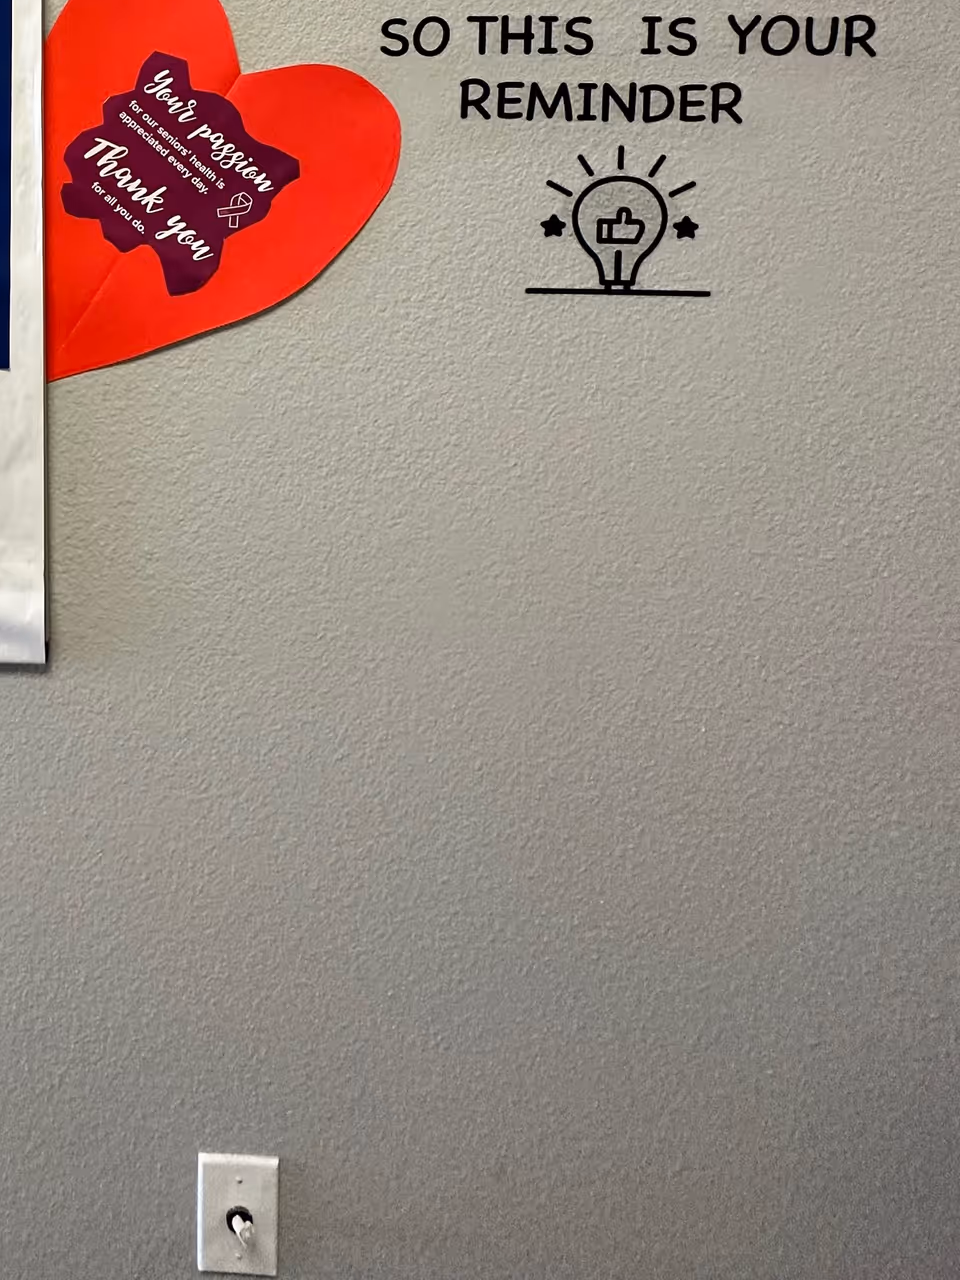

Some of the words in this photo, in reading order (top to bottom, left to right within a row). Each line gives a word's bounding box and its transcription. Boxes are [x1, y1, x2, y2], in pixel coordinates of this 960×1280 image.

[380, 16, 451, 57] SO
[467, 15, 594, 55] THIS
[641, 16, 697, 56] IS
[728, 14, 877, 58] YOUR
[459, 78, 743, 124] REMINDER
[119, 111, 169, 157] appreciated
[167, 155, 192, 179] every
[191, 177, 208, 195] day.
[128, 100, 143, 114] for
[142, 112, 158, 128] our
[156, 126, 192, 157] seniors'
[189, 152, 218, 183] health
[215, 178, 226, 190] is
[187, 123, 274, 192] passion
[84, 138, 169, 214] Thank
[155, 215, 214, 261] you
[91, 182, 105, 196] for
[104, 193, 116, 207] all
[114, 203, 133, 221] you
[131, 219, 145, 234] do.
